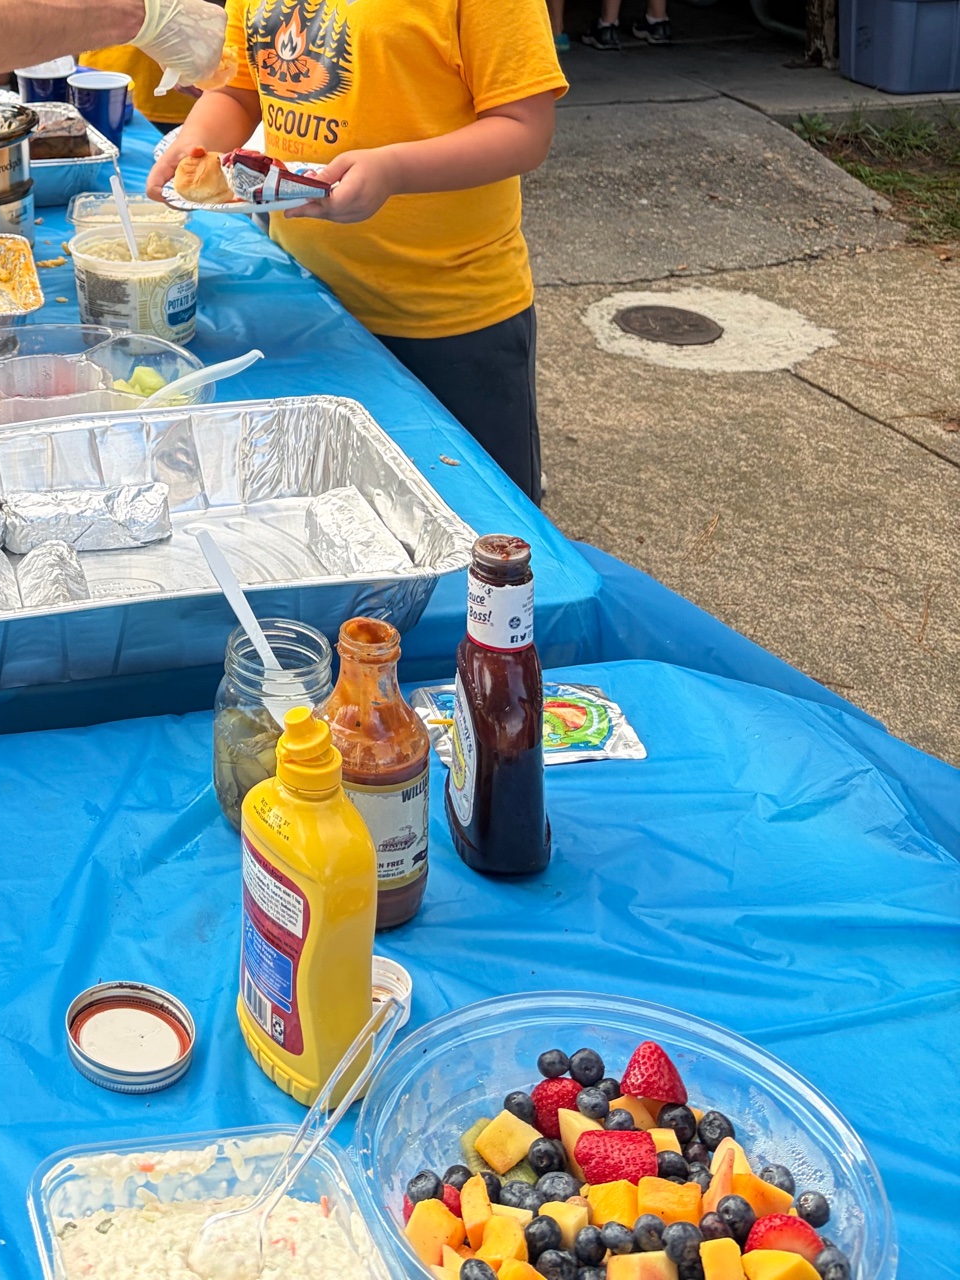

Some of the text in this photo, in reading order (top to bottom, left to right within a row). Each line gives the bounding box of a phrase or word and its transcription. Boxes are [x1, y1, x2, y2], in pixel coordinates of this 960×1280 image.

[167, 295, 190, 311] POTATO
[468, 591, 486, 605] auce
[469, 605, 492, 623] Boss!
[386, 859, 404, 868] FREE
